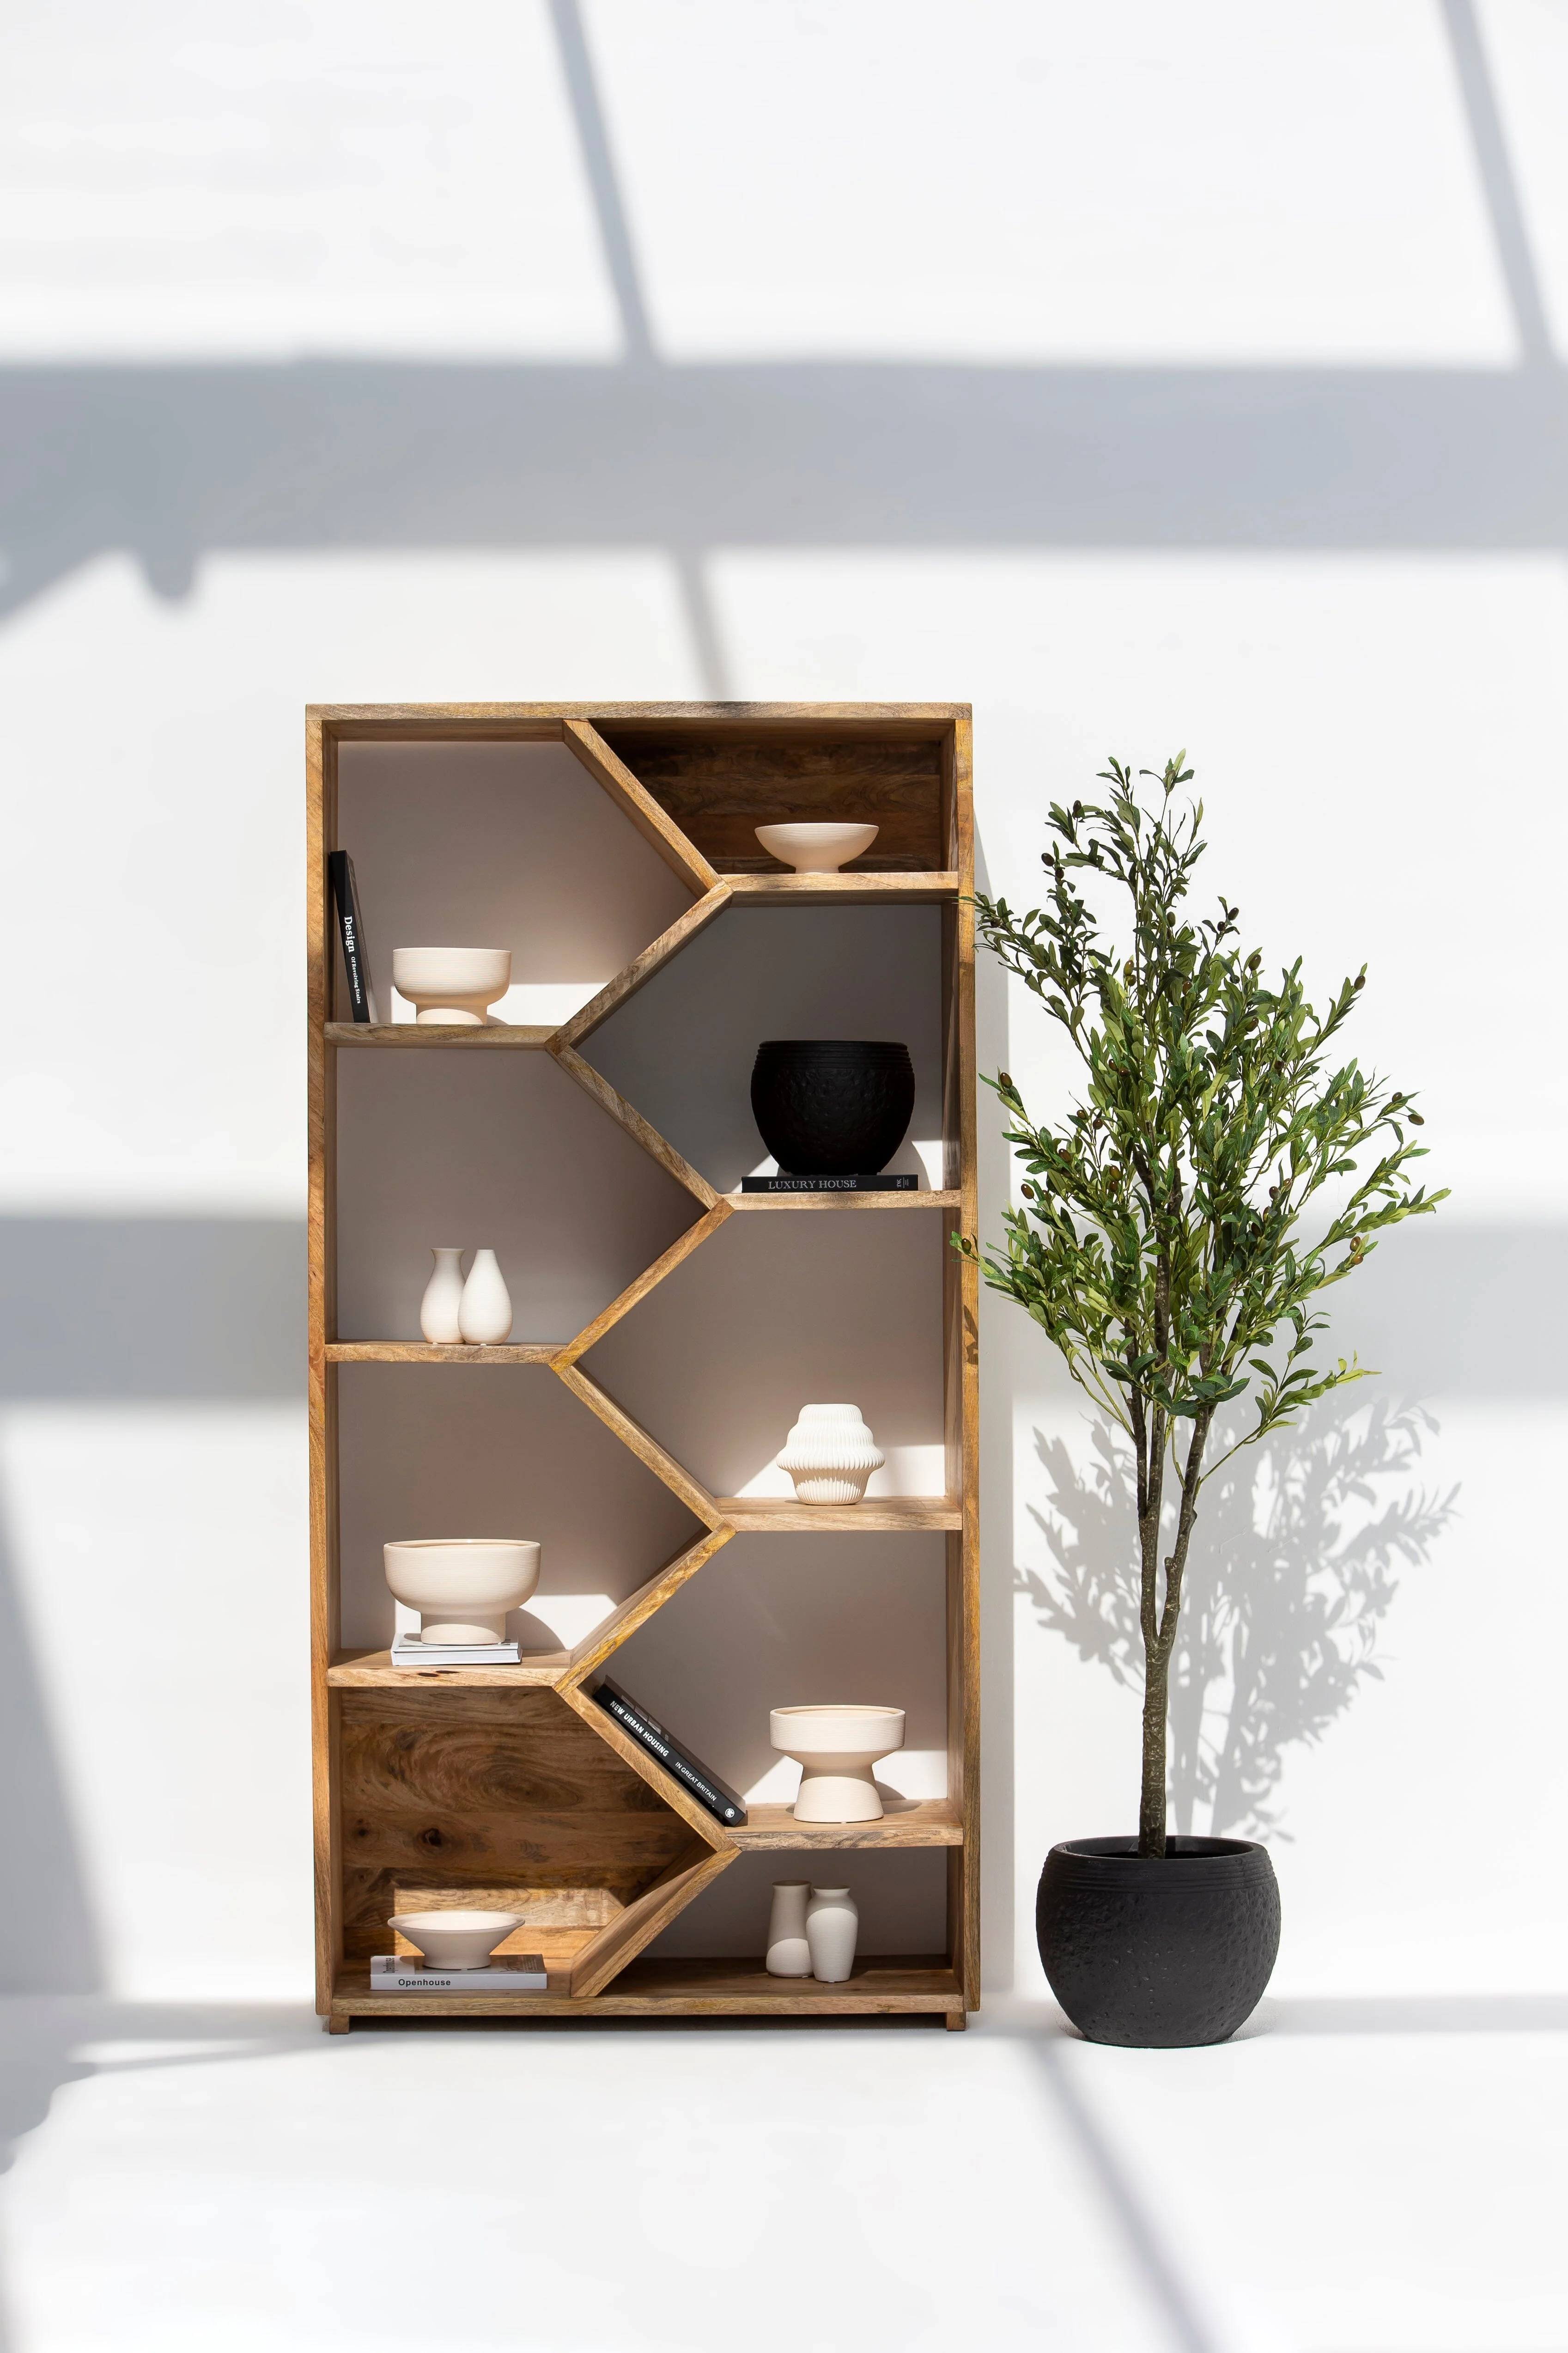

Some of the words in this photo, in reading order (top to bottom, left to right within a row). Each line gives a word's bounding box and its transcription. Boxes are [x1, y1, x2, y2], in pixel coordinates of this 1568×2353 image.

[344, 916, 355, 952] Design
[768, 1181, 815, 1189] LUXURY
[610, 1701, 625, 1715] NEW
[624, 1713, 644, 1733] URBAN
[643, 1731, 669, 1756] HOUSING
[681, 1768, 698, 1783] GREAT
[697, 1782, 717, 1801] BRITAIN
[398, 1979, 451, 1987] Openhouse
